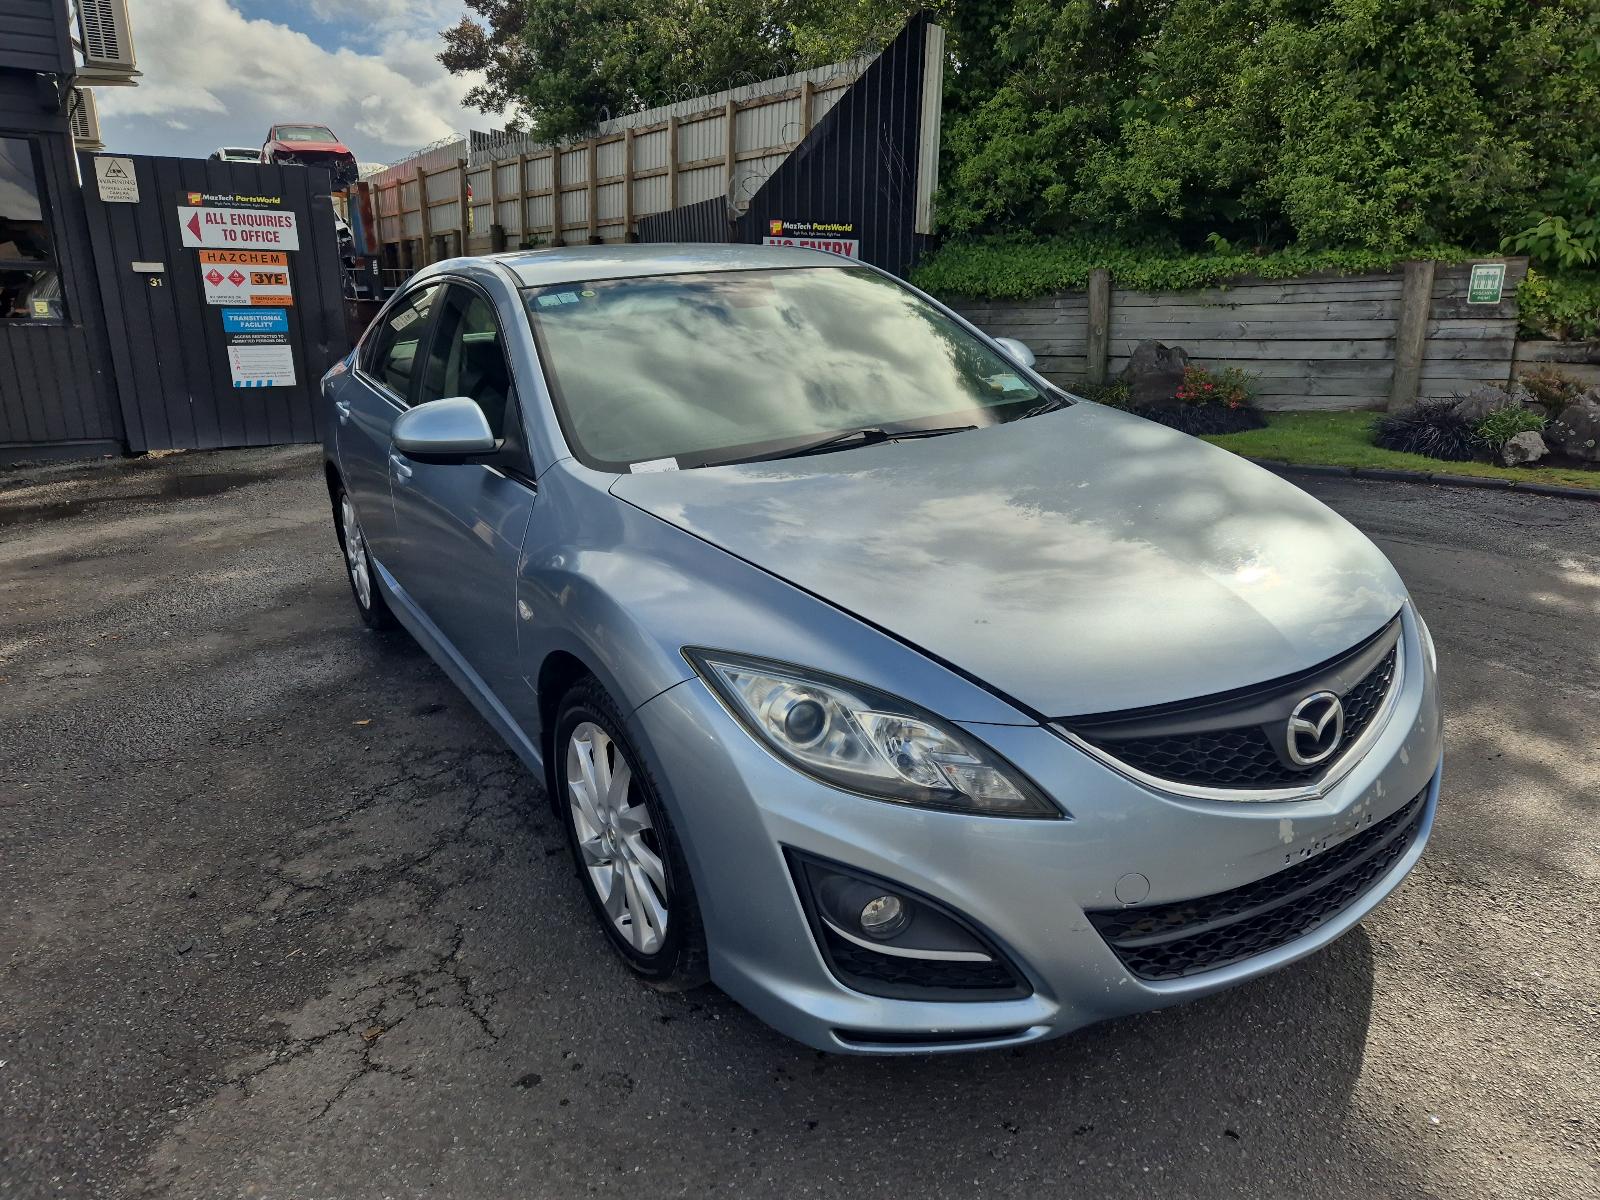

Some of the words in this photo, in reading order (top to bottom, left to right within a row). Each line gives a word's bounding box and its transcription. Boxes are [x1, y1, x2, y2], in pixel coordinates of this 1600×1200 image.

[236, 195, 280, 204] PartsWorld
[206, 212, 227, 224] ALL
[230, 213, 292, 228] ENQUIRIES
[812, 223, 853, 232] PartsWorld
[222, 229, 237, 241] TO
[241, 230, 280, 242] OFFICE
[208, 253, 280, 263] HAZCHEM
[150, 278, 162, 286] 31
[255, 274, 284, 284] 3YE
